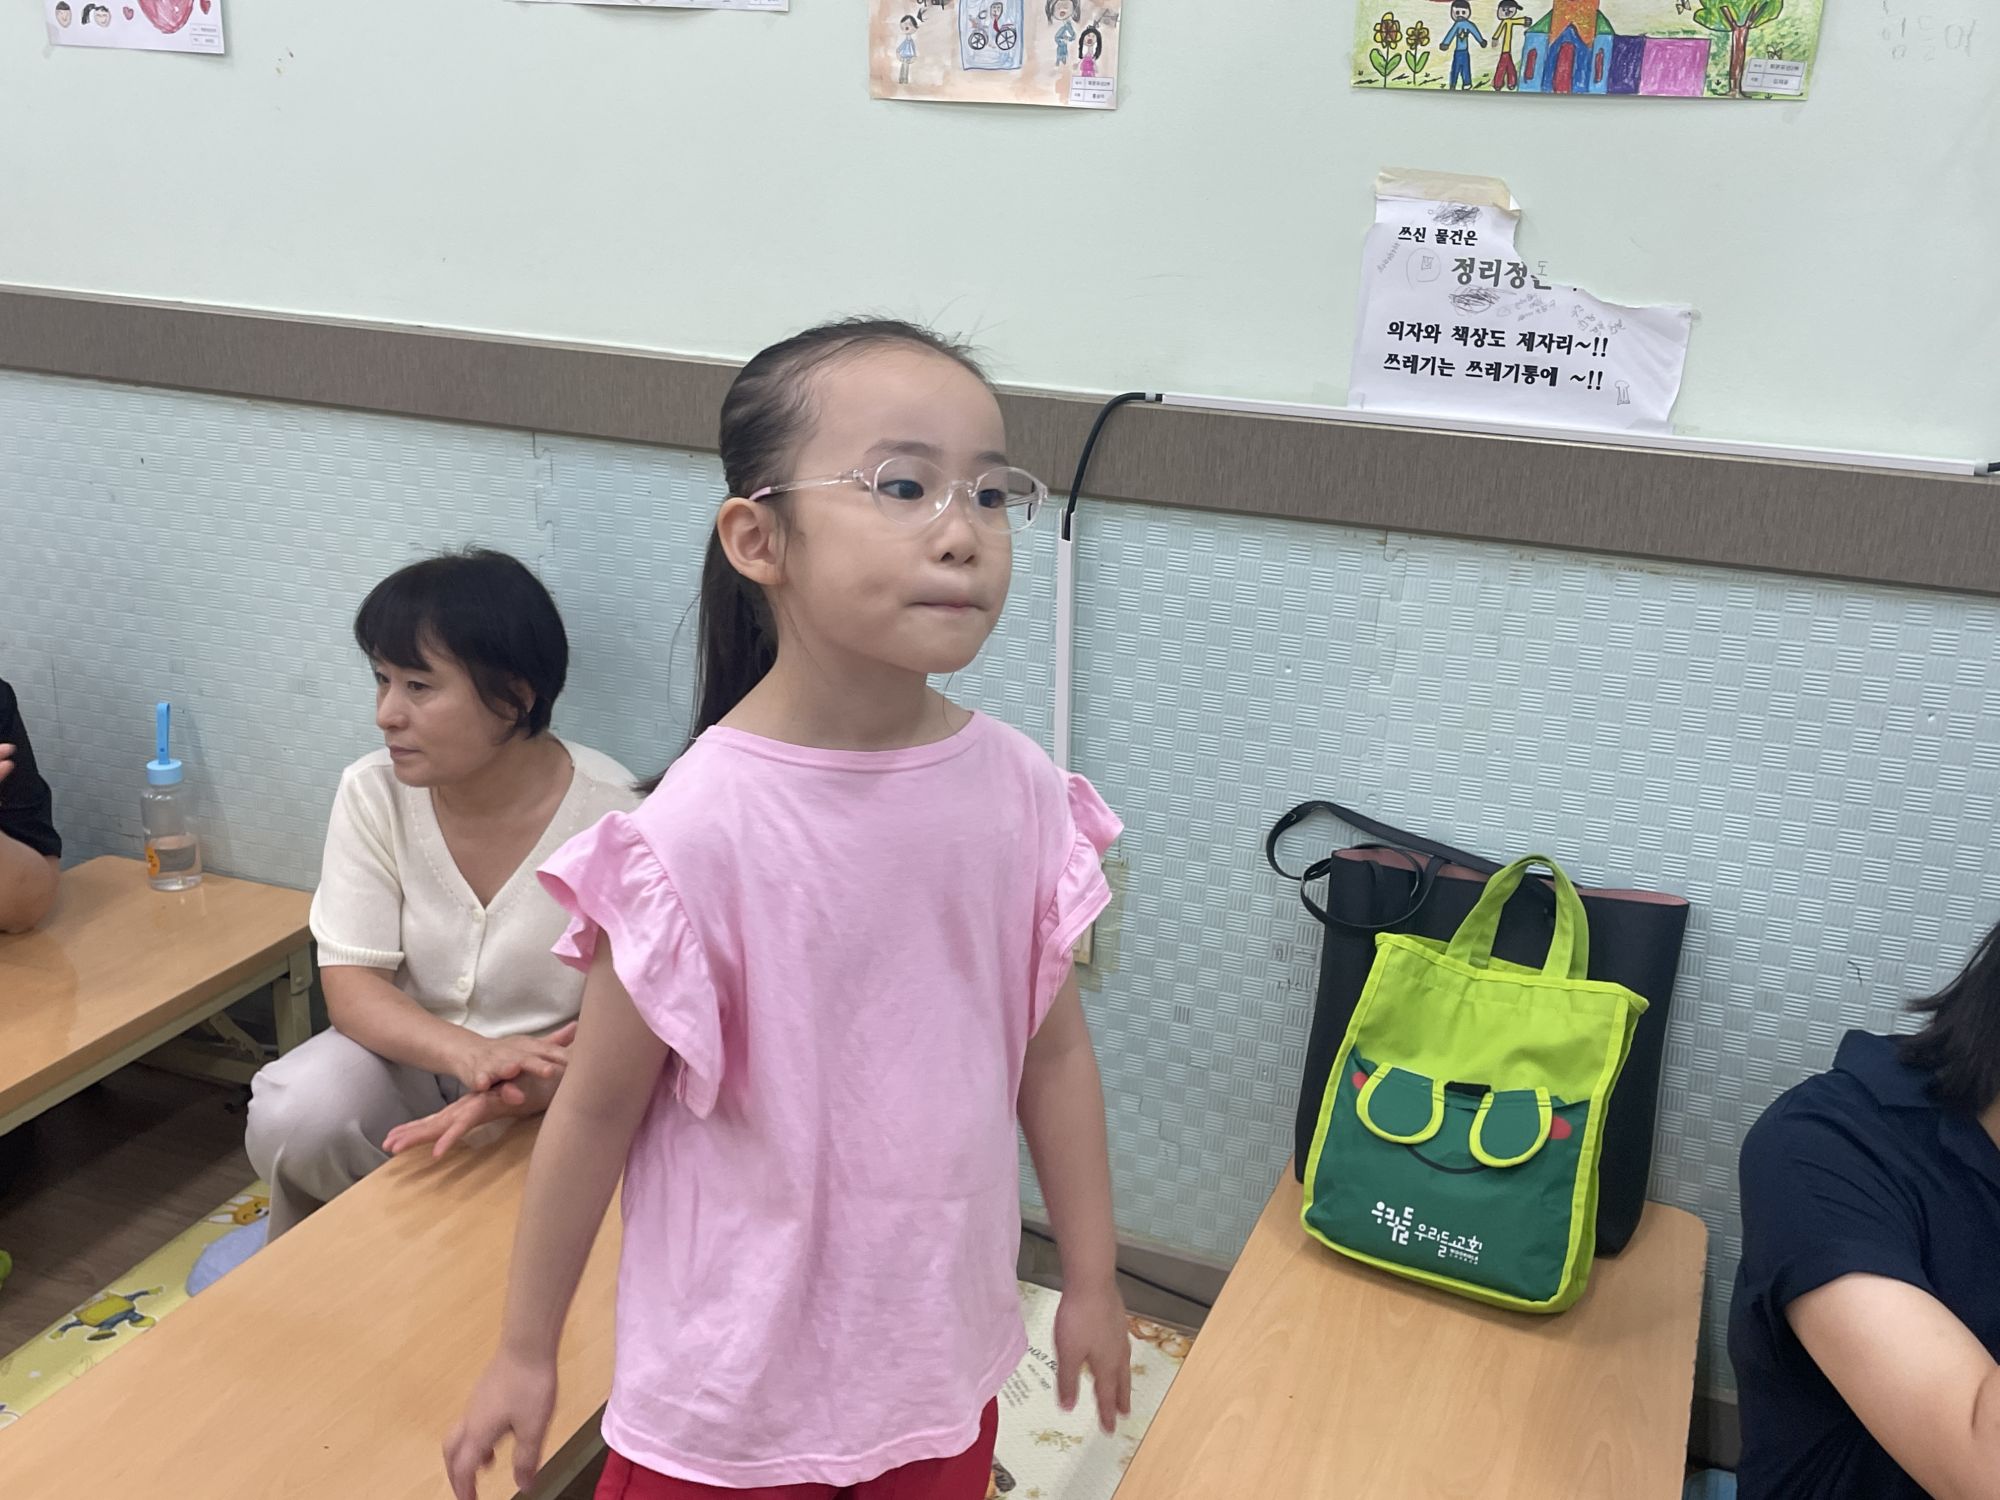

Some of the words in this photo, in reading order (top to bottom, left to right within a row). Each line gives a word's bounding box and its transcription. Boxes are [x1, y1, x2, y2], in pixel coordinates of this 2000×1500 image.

[1397, 226, 1428, 244] 쓰신
[1434, 228, 1479, 247] 물건은
[1386, 320, 1442, 344] 의자와
[1450, 325, 1506, 349] 책상도
[1516, 331, 1609, 358] 제자리~!!
[1382, 352, 1456, 378] 쓰레기는
[1464, 360, 1559, 387] 쓰레기통에
